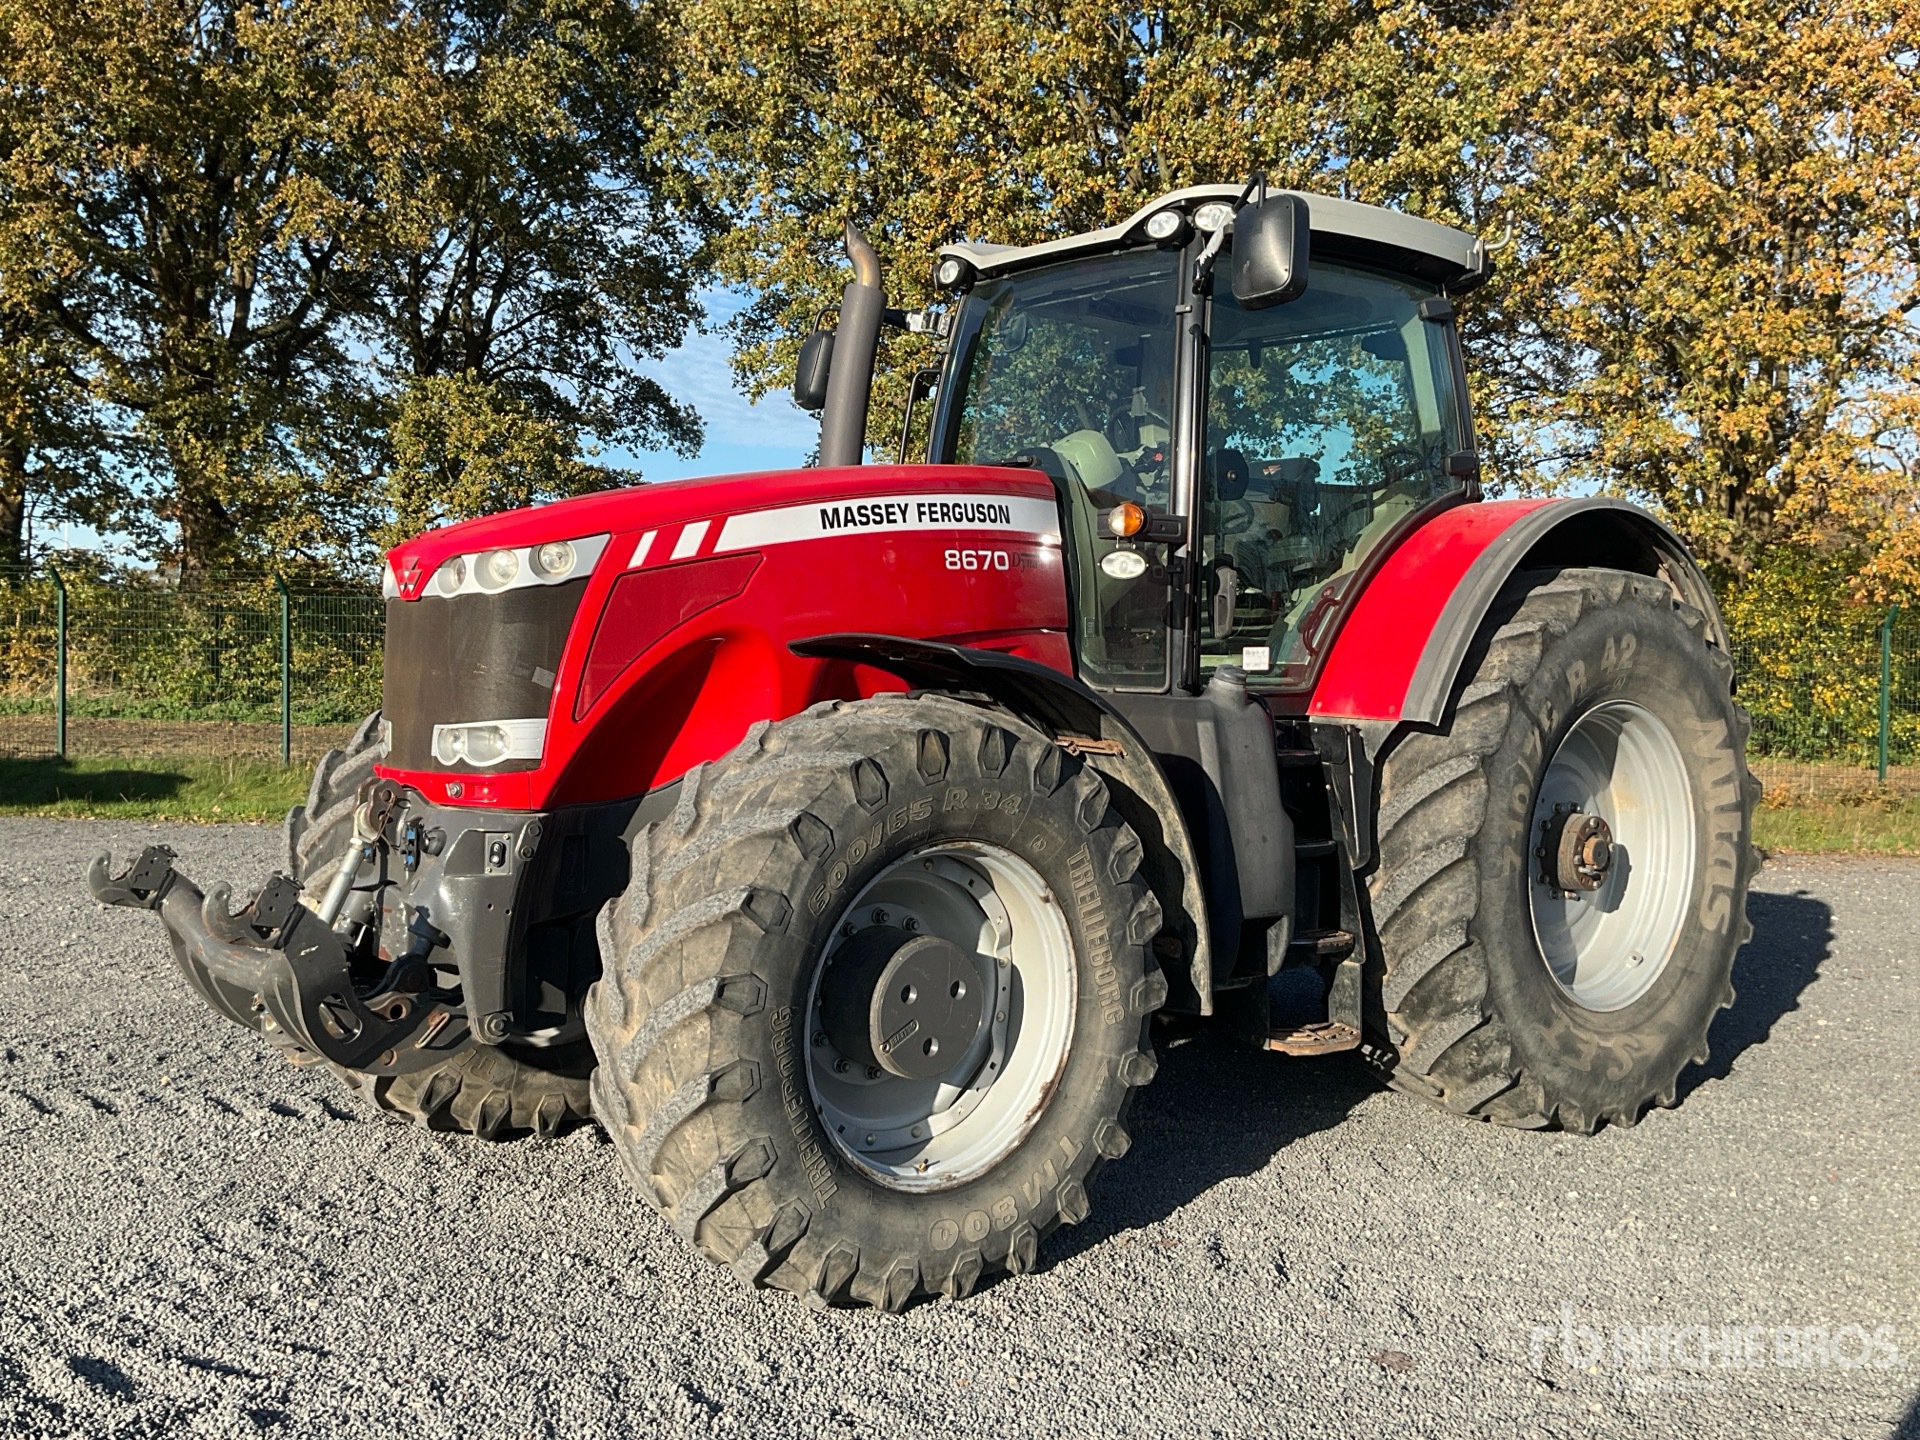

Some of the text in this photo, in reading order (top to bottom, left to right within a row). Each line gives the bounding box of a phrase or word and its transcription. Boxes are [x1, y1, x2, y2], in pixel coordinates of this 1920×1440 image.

[819, 502, 1011, 530] MASSEY FERGUSON
[944, 549, 1010, 571] 8670
[1565, 659, 1588, 704] R
[1600, 632, 1638, 672] 42
[943, 787, 970, 812] R
[976, 788, 1024, 815] 34
[1686, 718, 1743, 936] Mitas
[1067, 843, 1125, 1026] TRELLEBORG
[929, 1135, 1085, 1251] TM 800
